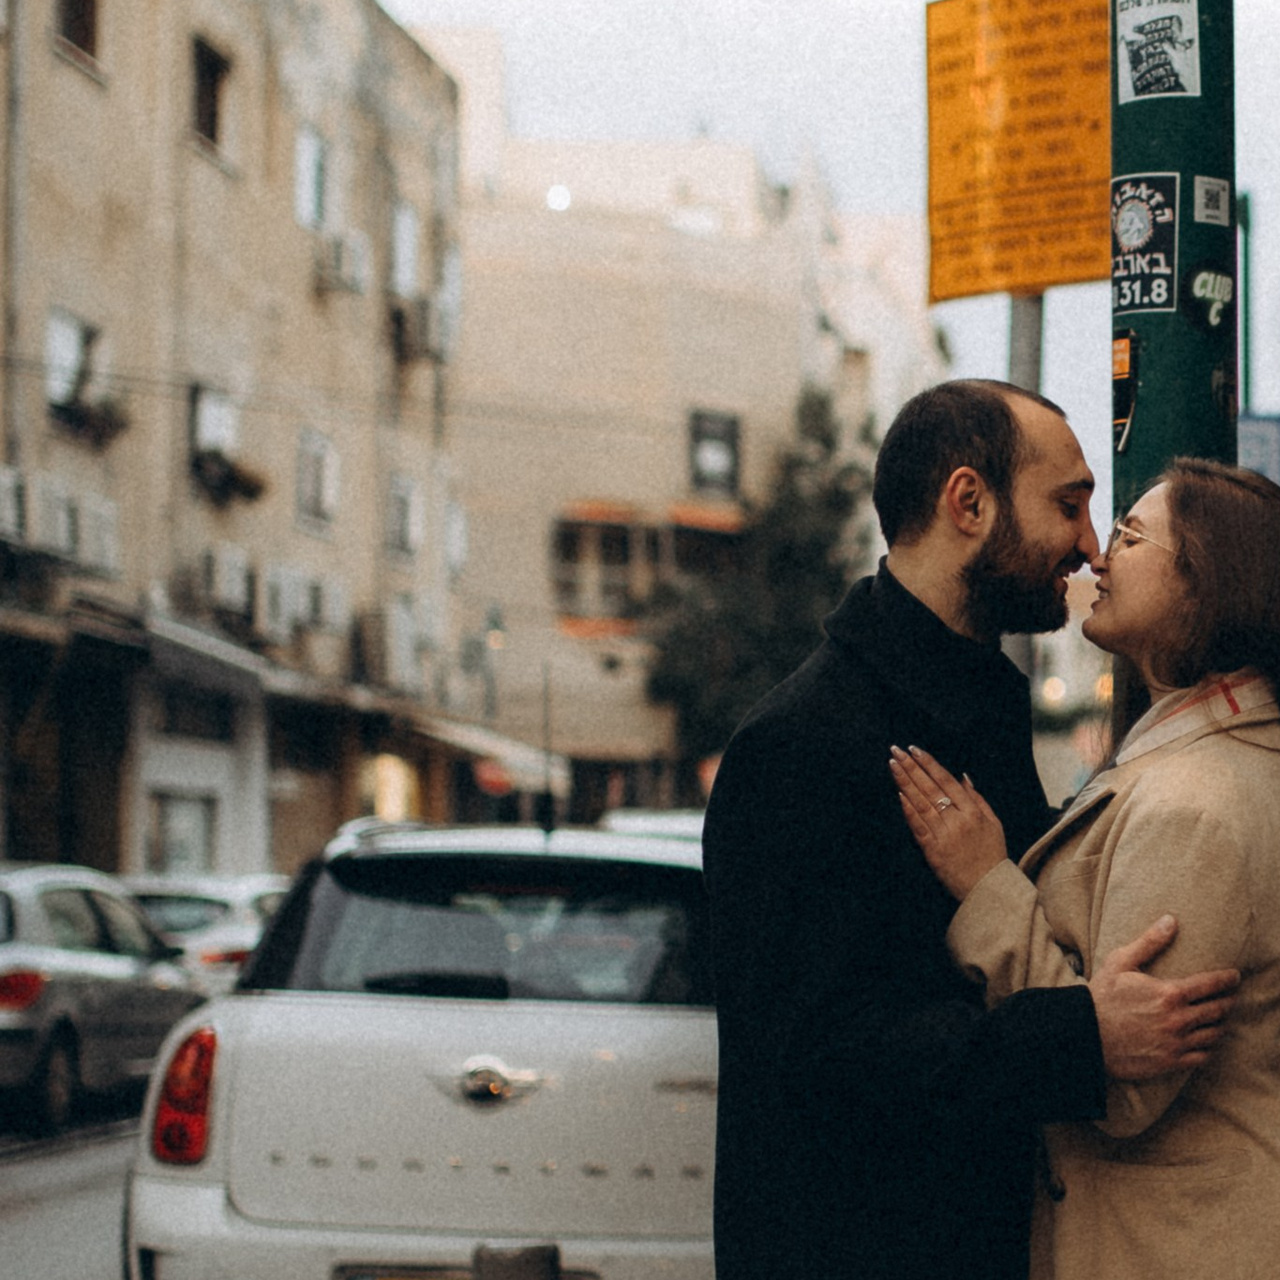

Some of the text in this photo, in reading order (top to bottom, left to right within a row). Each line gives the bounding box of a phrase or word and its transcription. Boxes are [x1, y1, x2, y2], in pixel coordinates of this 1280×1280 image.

[1112, 252, 1172, 278] בארב
[1119, 278, 1169, 306] 31.8
[1193, 271, 1234, 304] CLUB
